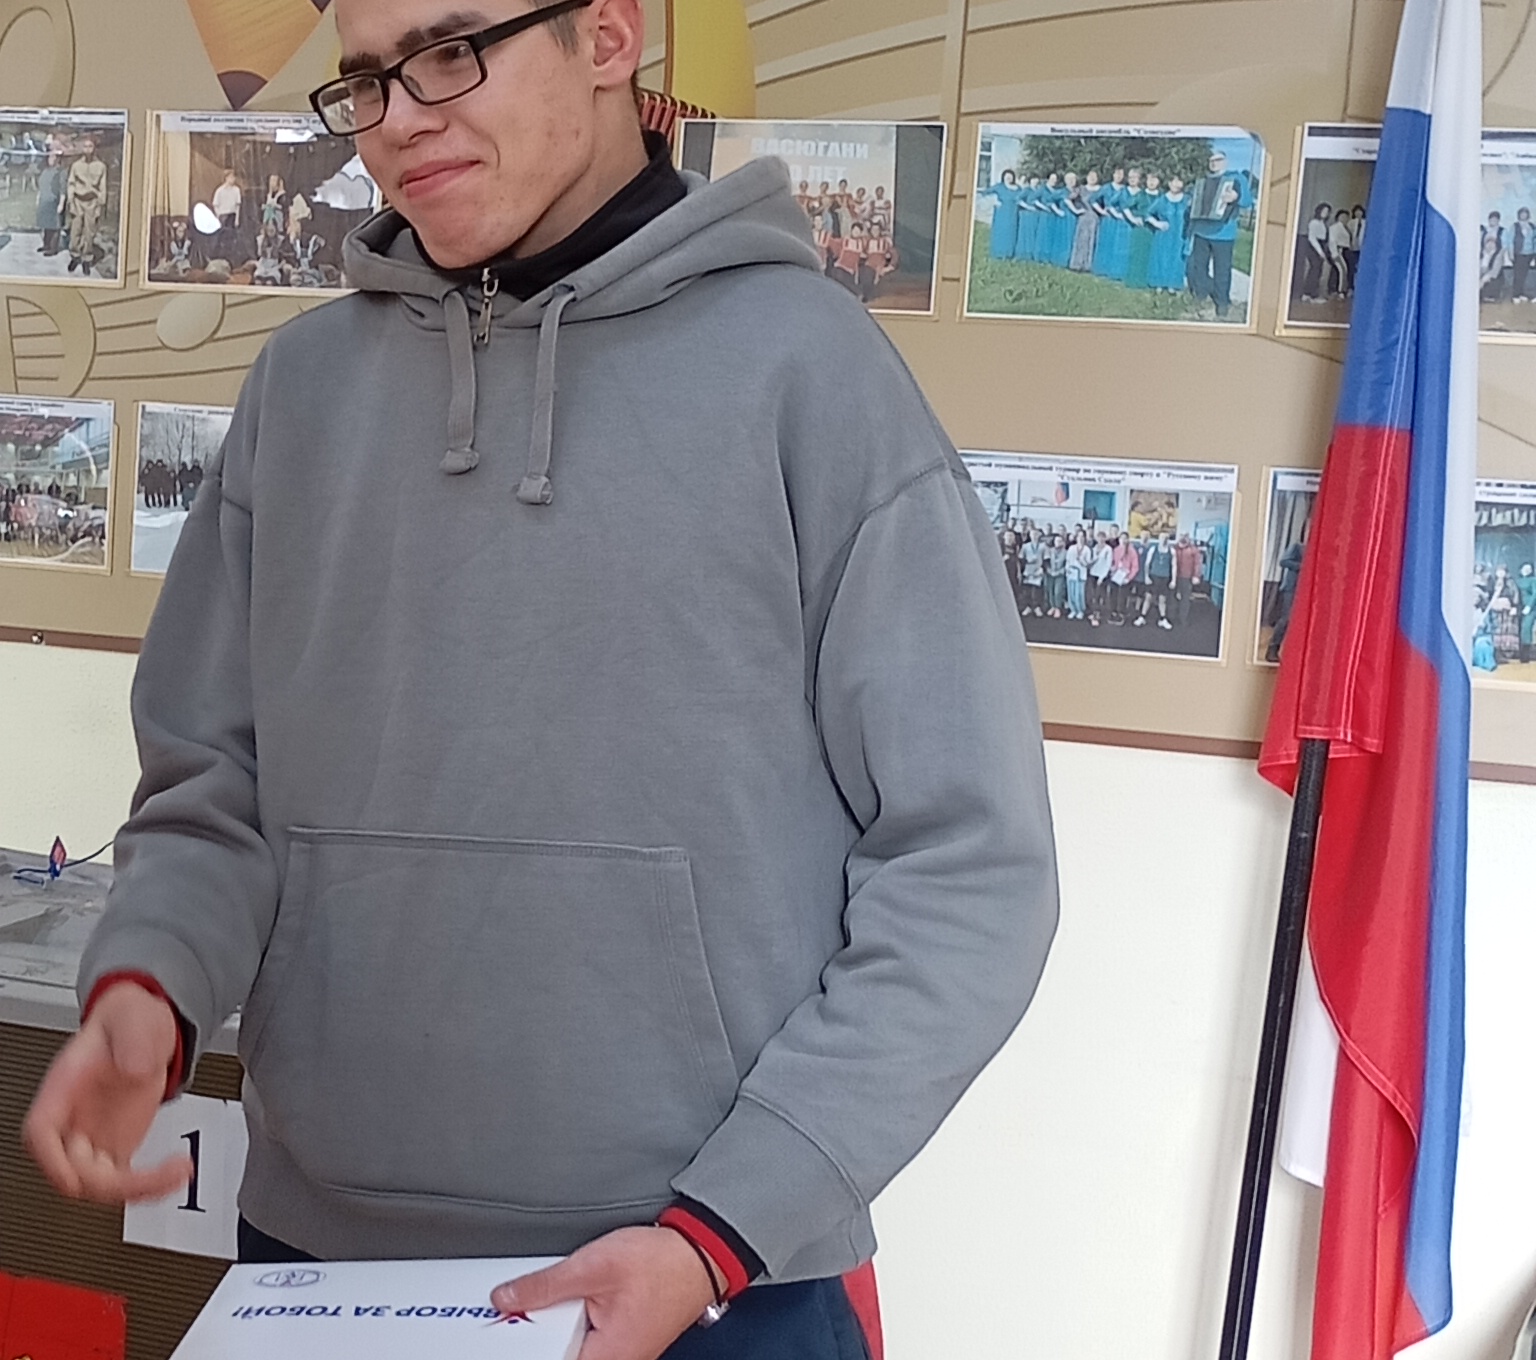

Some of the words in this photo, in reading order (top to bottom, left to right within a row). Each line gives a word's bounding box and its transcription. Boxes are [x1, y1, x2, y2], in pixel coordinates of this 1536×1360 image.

[177, 1129, 207, 1214] 1
[231, 1305, 343, 1321] ТОБОЙ!
[353, 1305, 392, 1318] ЗА
